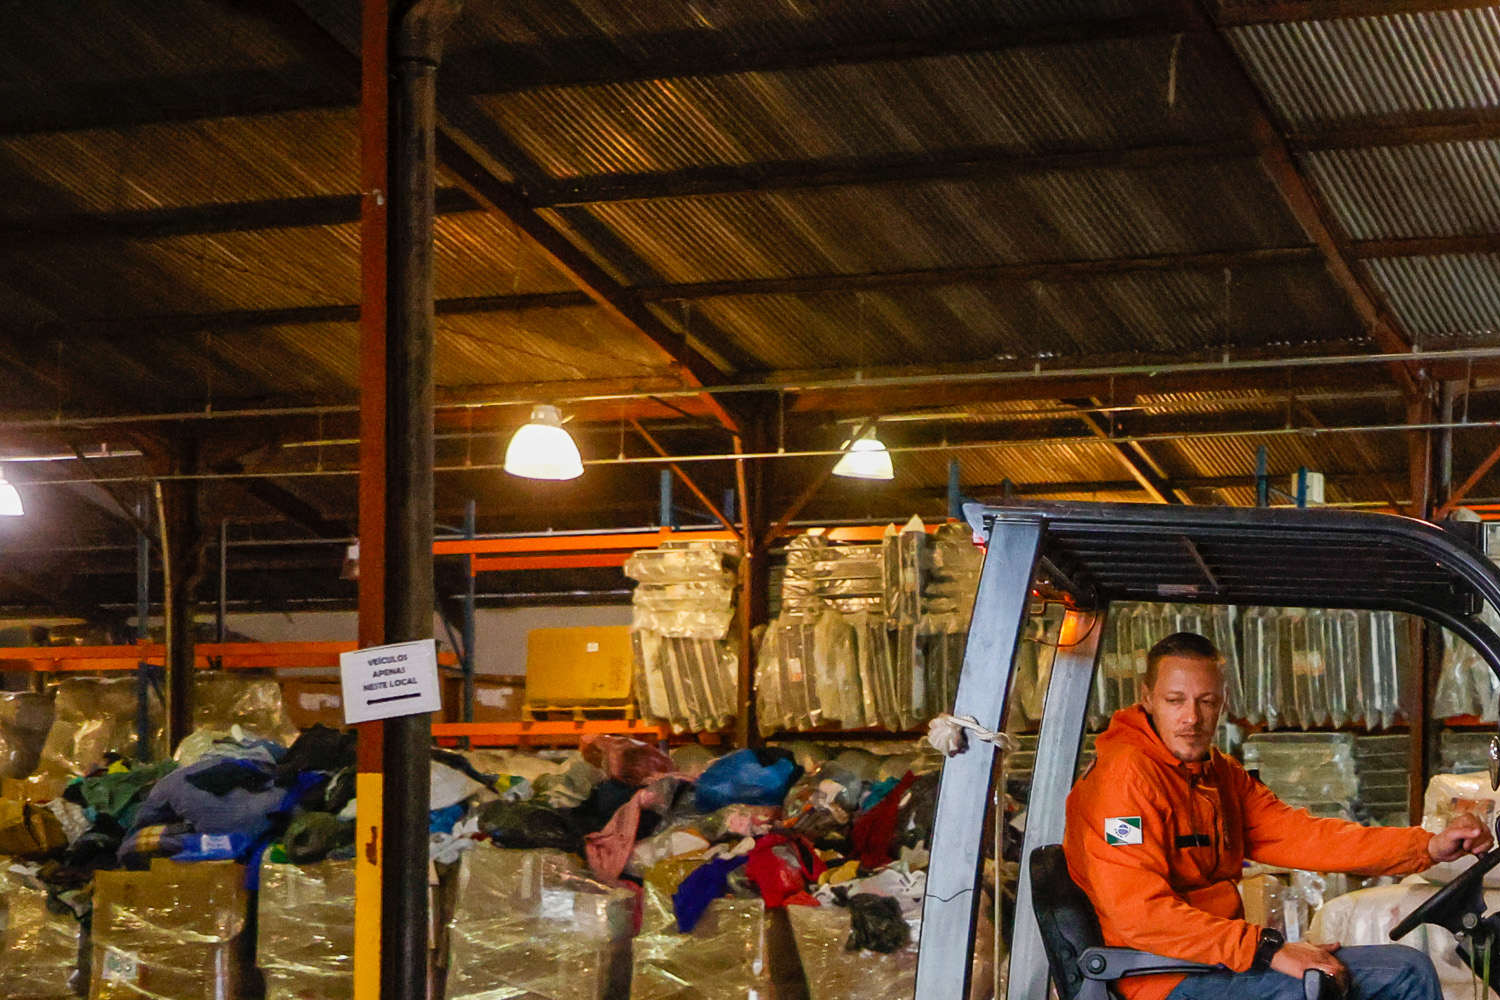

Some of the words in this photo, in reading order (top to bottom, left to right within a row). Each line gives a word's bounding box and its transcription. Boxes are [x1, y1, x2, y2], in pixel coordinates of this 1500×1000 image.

[367, 653, 408, 667] VEÍCULOS
[372, 666, 406, 679] APENAS
[363, 681, 388, 692] NESTE
[389, 677, 418, 689] LOCAL
